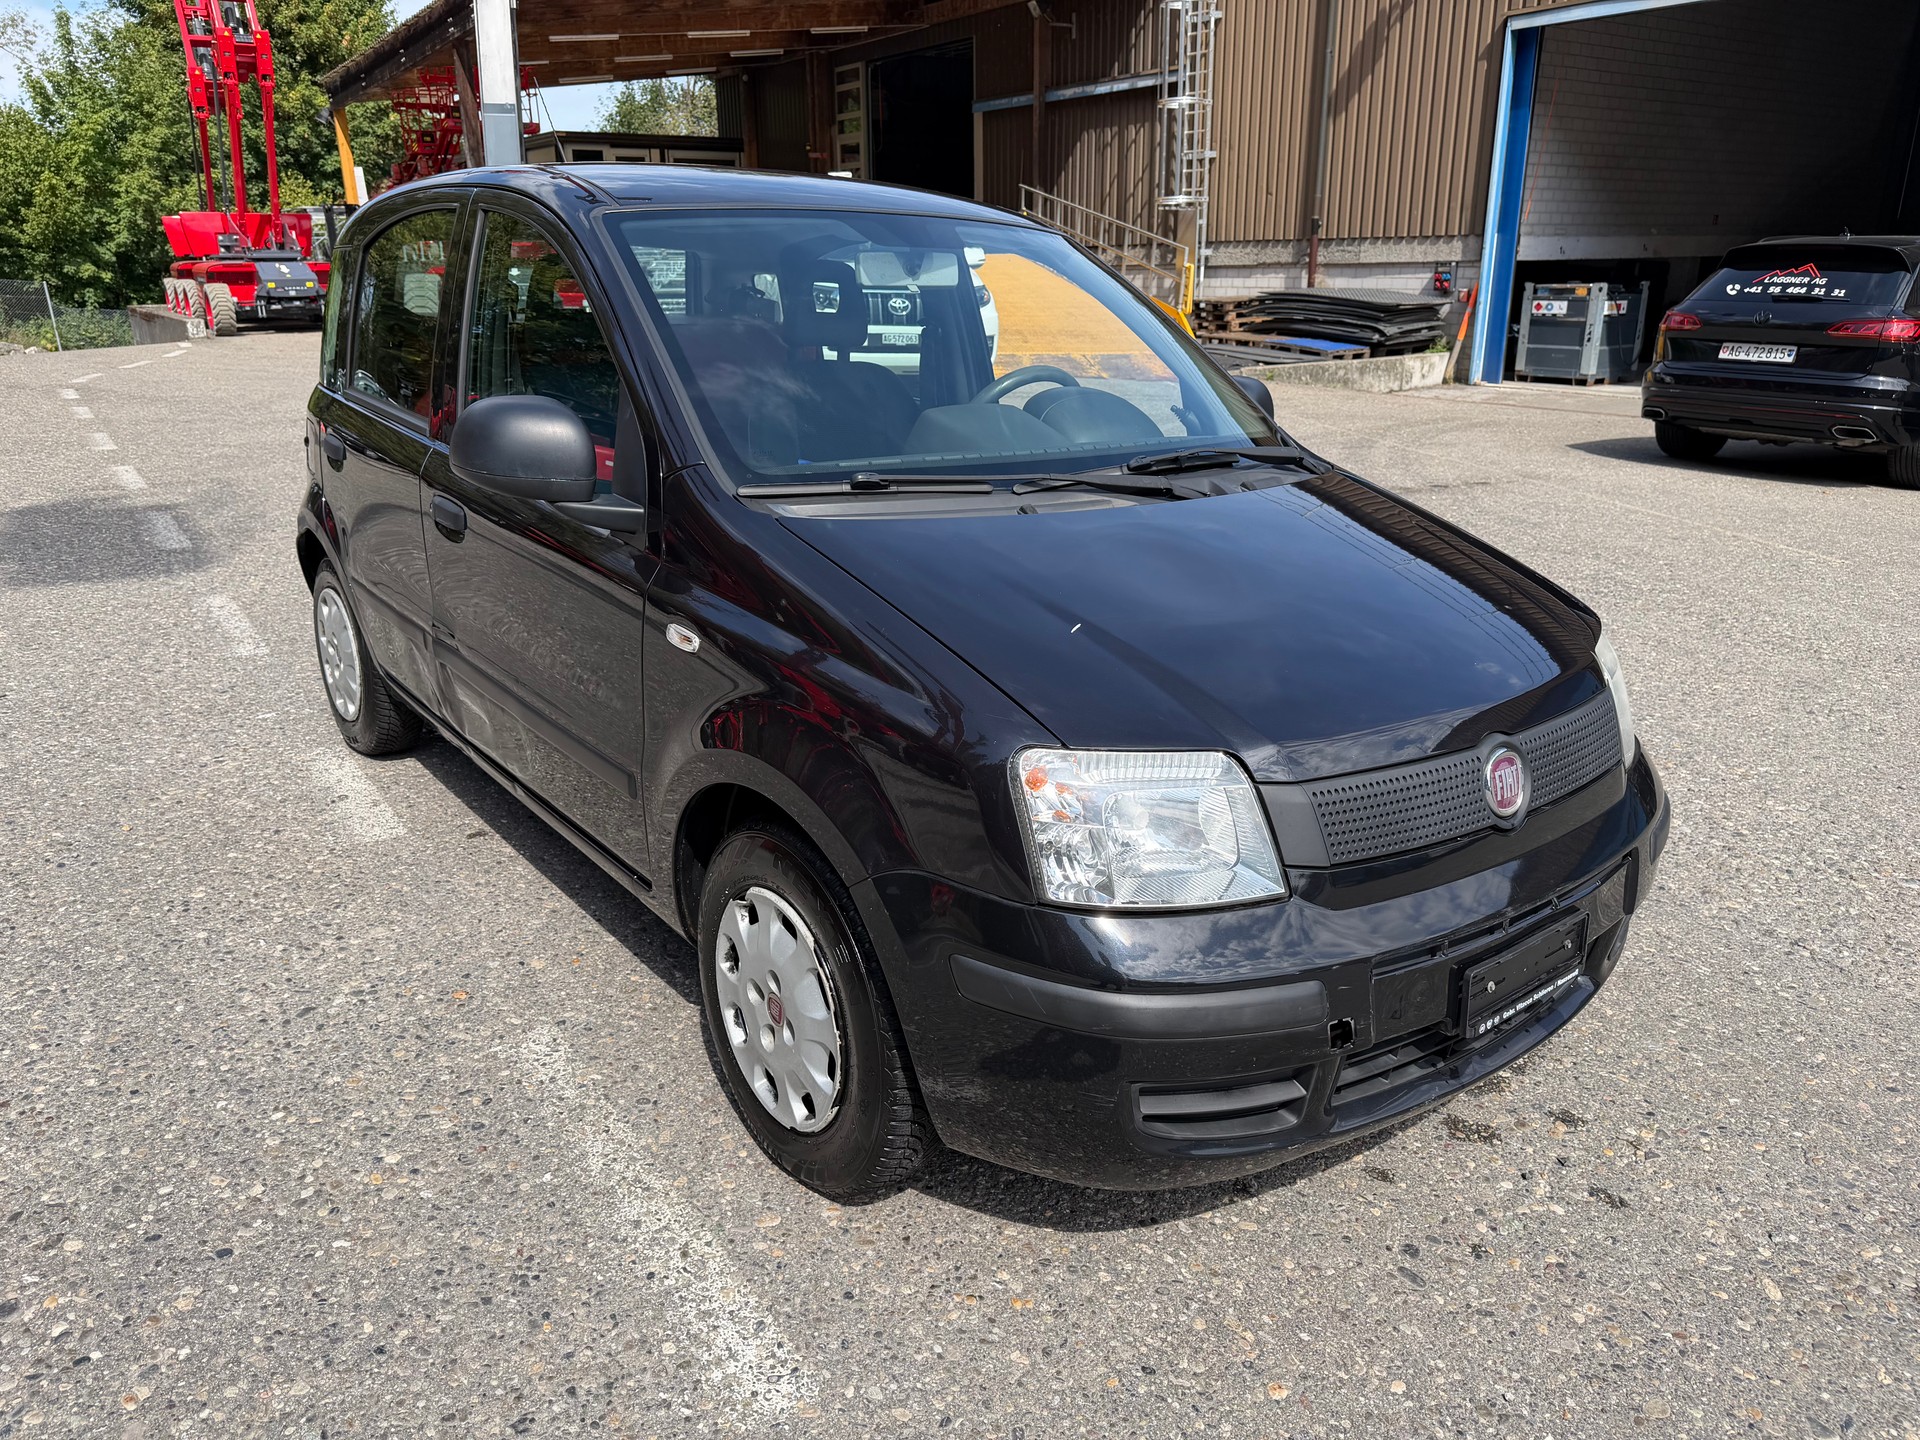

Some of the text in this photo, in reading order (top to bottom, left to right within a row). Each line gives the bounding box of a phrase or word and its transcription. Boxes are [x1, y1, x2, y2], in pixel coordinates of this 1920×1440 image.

[1764, 276, 1828, 285] LAGGNER AG
[1785, 286, 1807, 294] 464
[1811, 287, 1826, 295] 31
[1830, 288, 1846, 297] 31
[1494, 764, 1518, 801] FIAT
